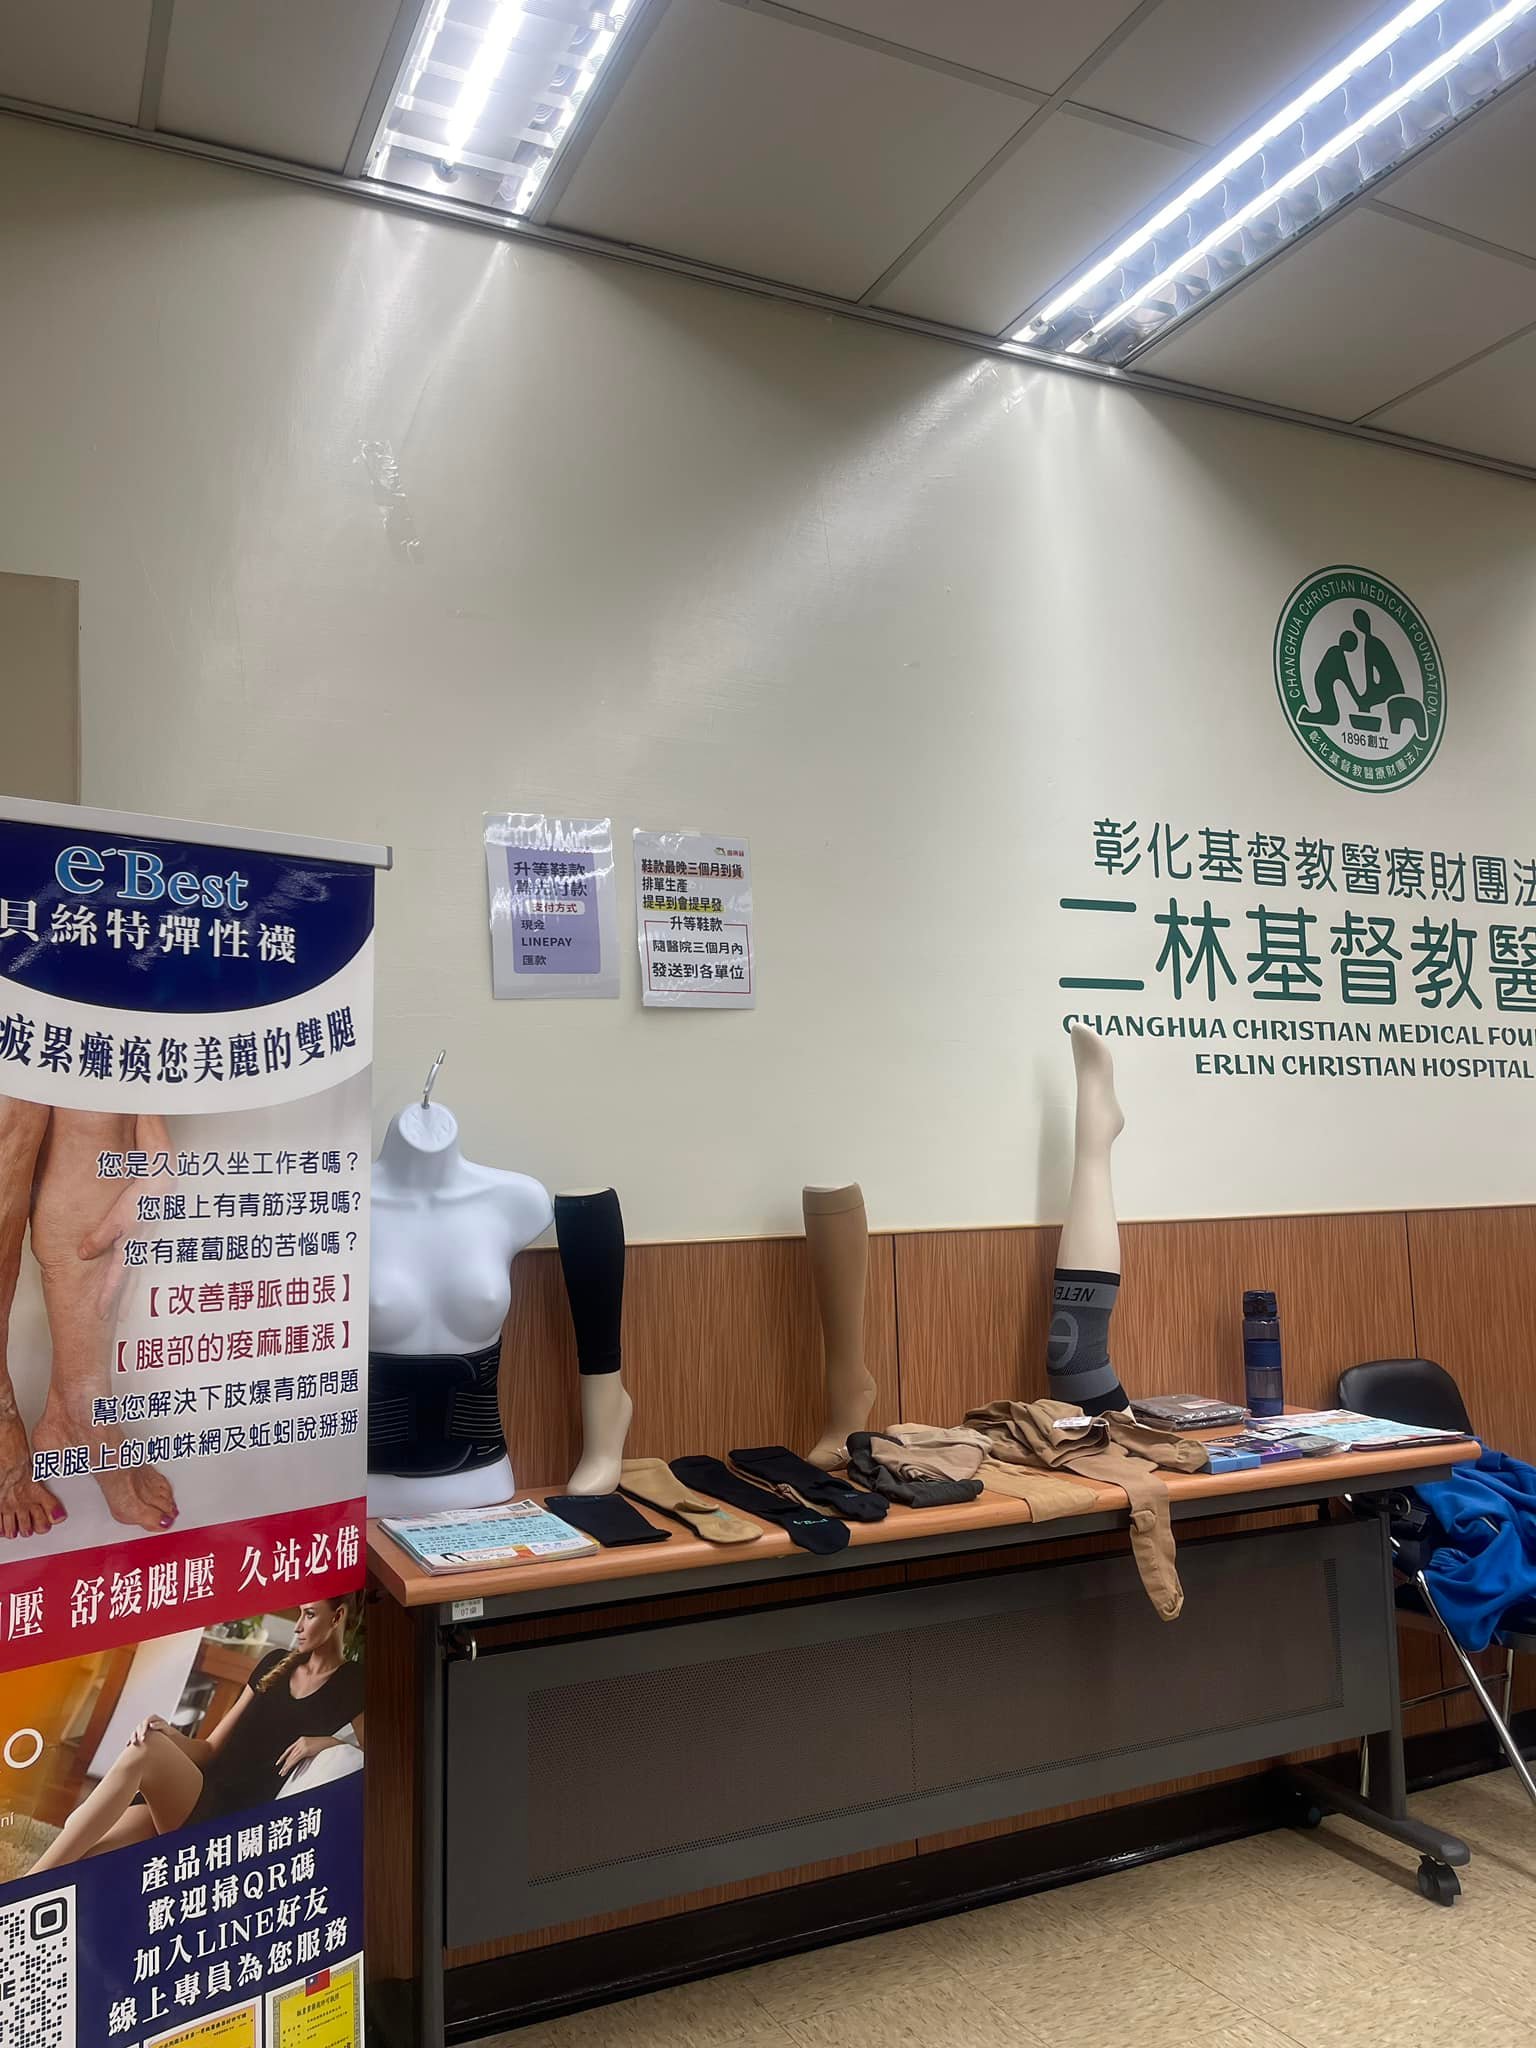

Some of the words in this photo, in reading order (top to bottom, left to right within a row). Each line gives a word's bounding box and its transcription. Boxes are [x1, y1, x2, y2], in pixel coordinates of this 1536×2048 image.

[1284, 617, 1304, 698] CHANGHUA
[1299, 579, 1356, 617] CHRISTIAN
[1360, 582, 1407, 623] MEDICAL
[1409, 622, 1439, 716] FOUNDATION
[1341, 731, 1389, 750] 1896創立
[513, 861, 586, 877] 升等鞋款
[641, 858, 743, 879] 鞋款最晚三個月到貨
[642, 876, 688, 893] 排單生產
[533, 902, 578, 913] 支付方式
[0, 897, 297, 964] 貝絲特彈性襪
[521, 919, 545, 931] 現金
[670, 916, 723, 932] 升等鞋款
[521, 937, 573, 947] LINEPAY
[652, 939, 744, 955] 隨醫院三個月內
[522, 954, 547, 966] 匯款
[652, 962, 745, 980] 發送到各單位
[1062, 1014, 1227, 1038] CHANGHUA
[1232, 1018, 1372, 1043] CHRISTIAN
[1378, 1023, 1484, 1046] MEDICAL
[1488, 1026, 1536, 1046] FOU
[1195, 1053, 1275, 1076] ERLIN
[1281, 1055, 1416, 1077] CHRISTIAN
[1422, 1057, 1534, 1079] HOSPITAL
[0, 1586, 44, 1642] 壓
[70, 1553, 216, 1629] 舒緩腿壓
[238, 1526, 360, 1593] 久站必備
[140, 1807, 323, 1895] 產品相關諮詢
[148, 1848, 316, 1935] 歡迎掃QR碼
[133, 1886, 329, 1985] 加入LINE好友
[108, 1916, 348, 2037] 線上專員為您服務
